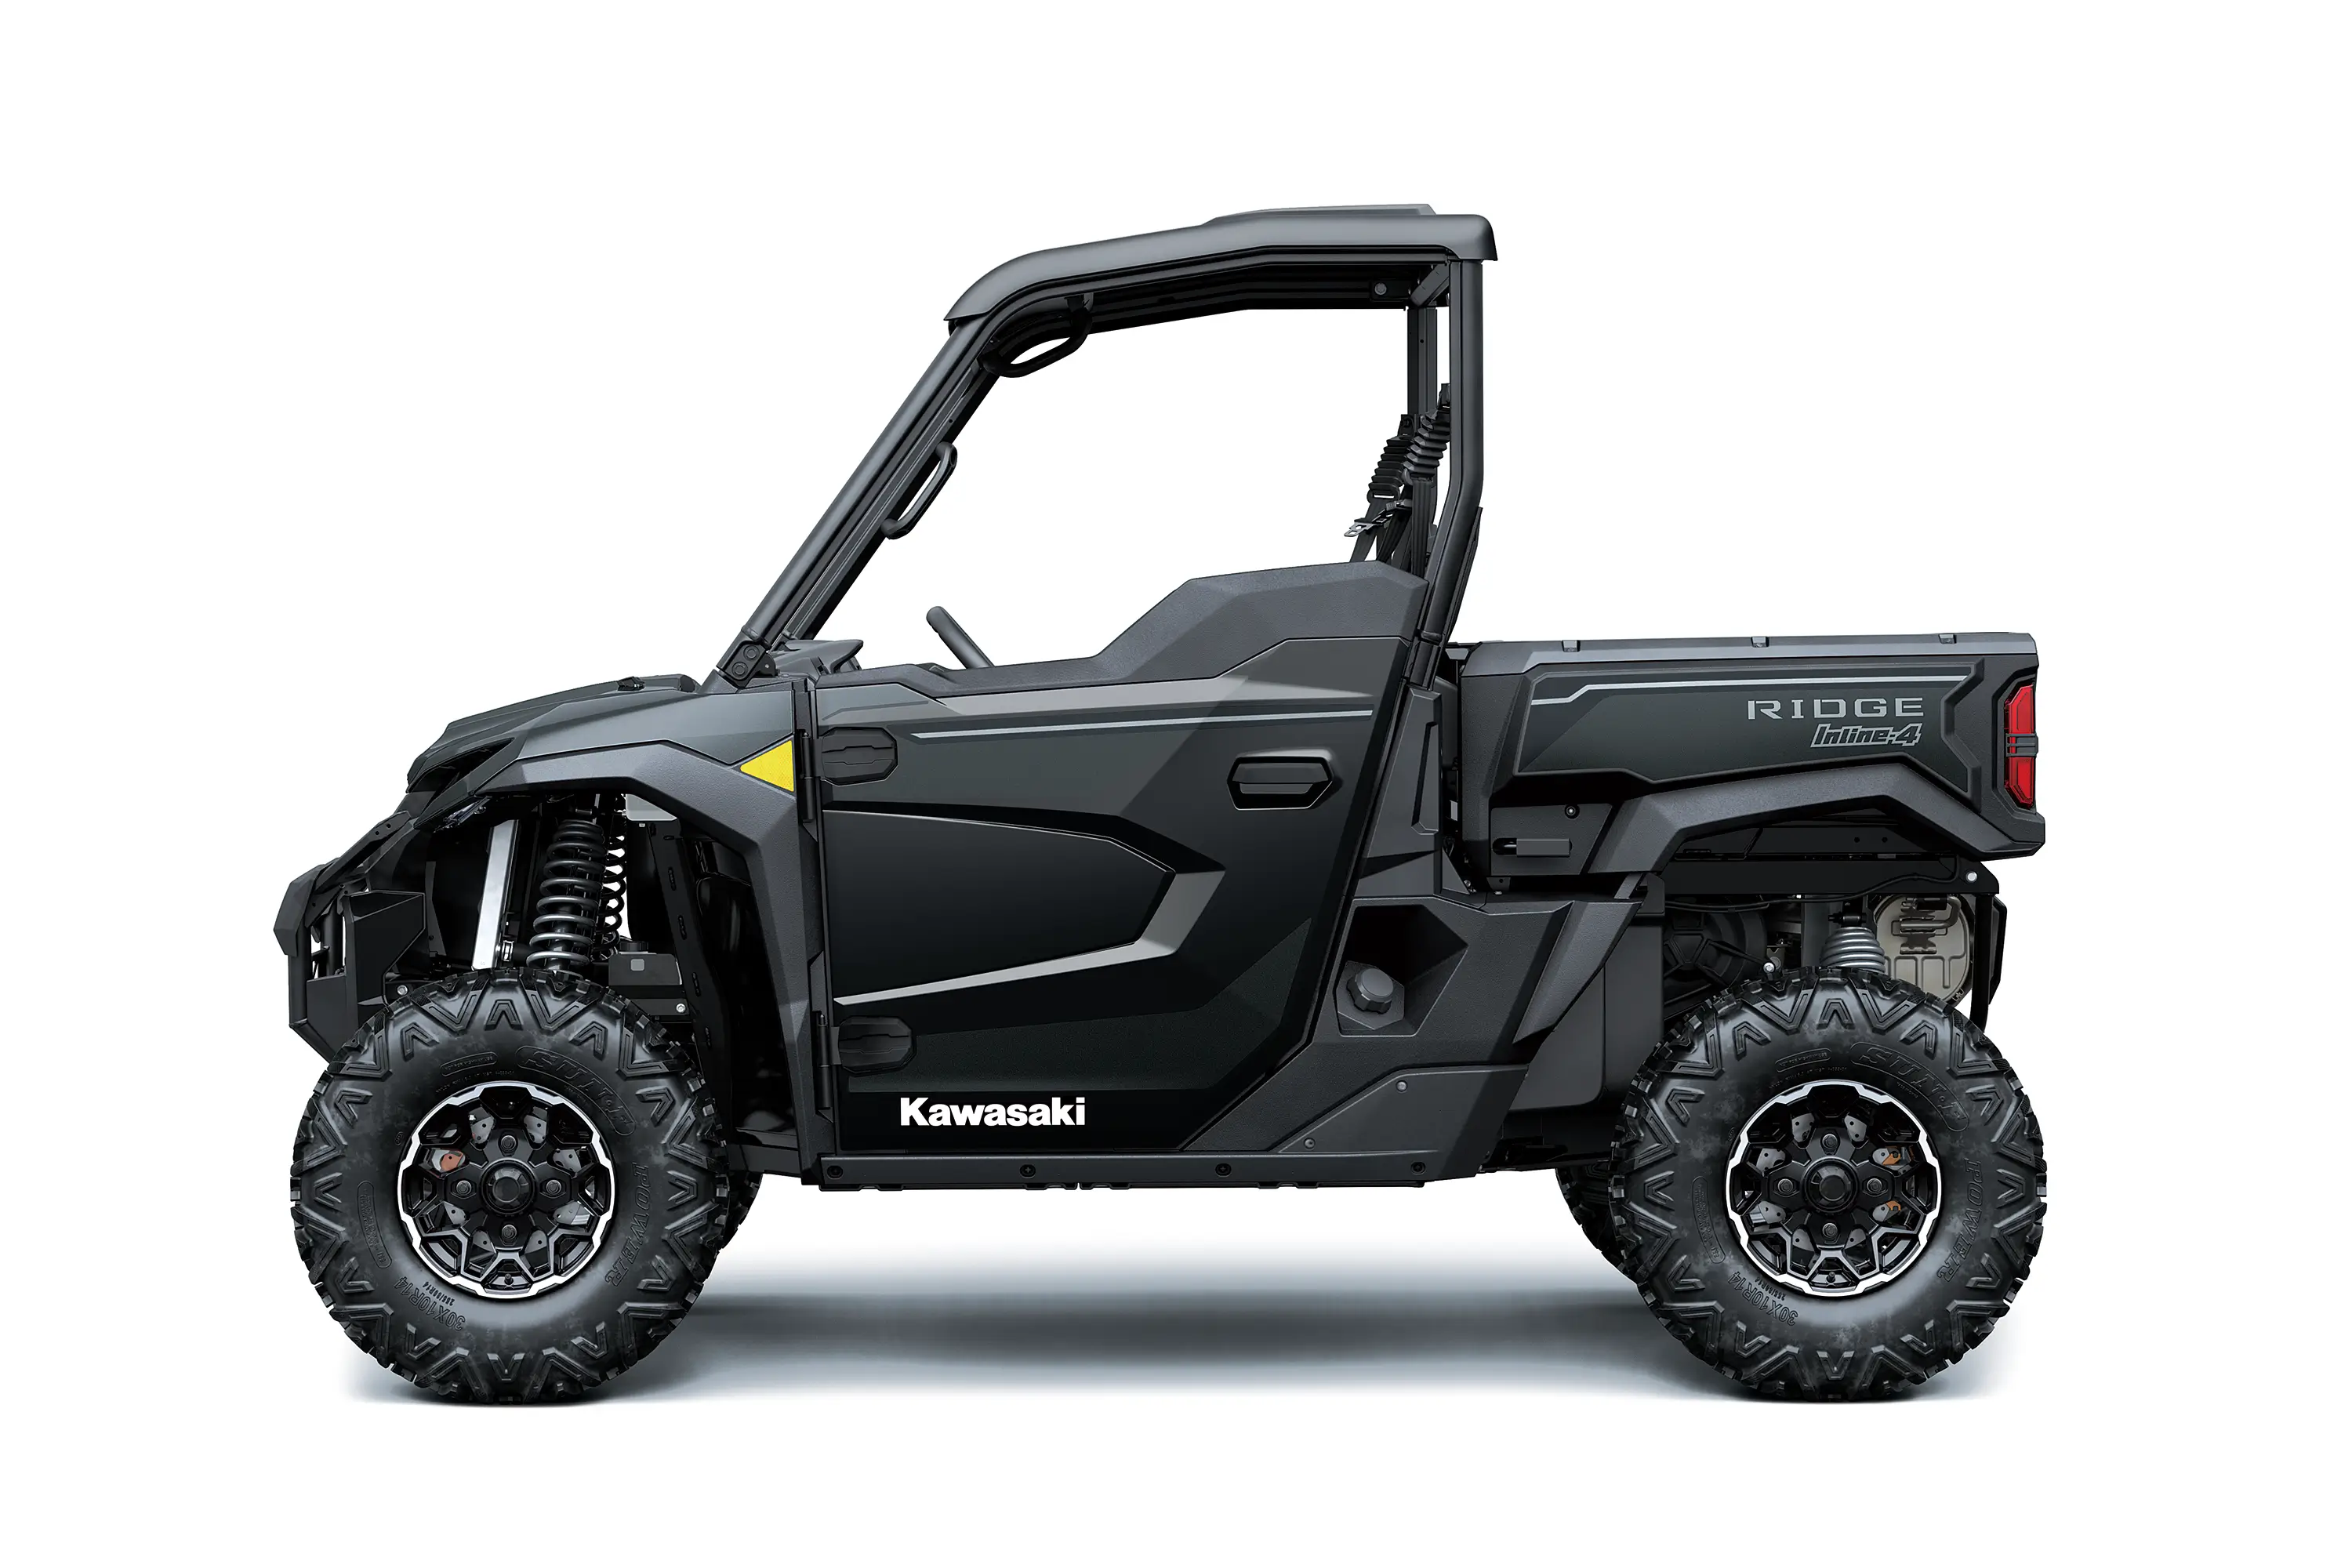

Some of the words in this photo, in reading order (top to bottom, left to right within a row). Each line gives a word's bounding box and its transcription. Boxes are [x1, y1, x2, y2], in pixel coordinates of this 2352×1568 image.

[1748, 697, 1924, 720] RIDGE
[1810, 723, 1922, 747] Inline-4
[901, 1097, 1085, 1127] Kawasaki
[394, 1276, 466, 1331] 30X10R14
[1727, 1271, 1798, 1327] 30X10R14
